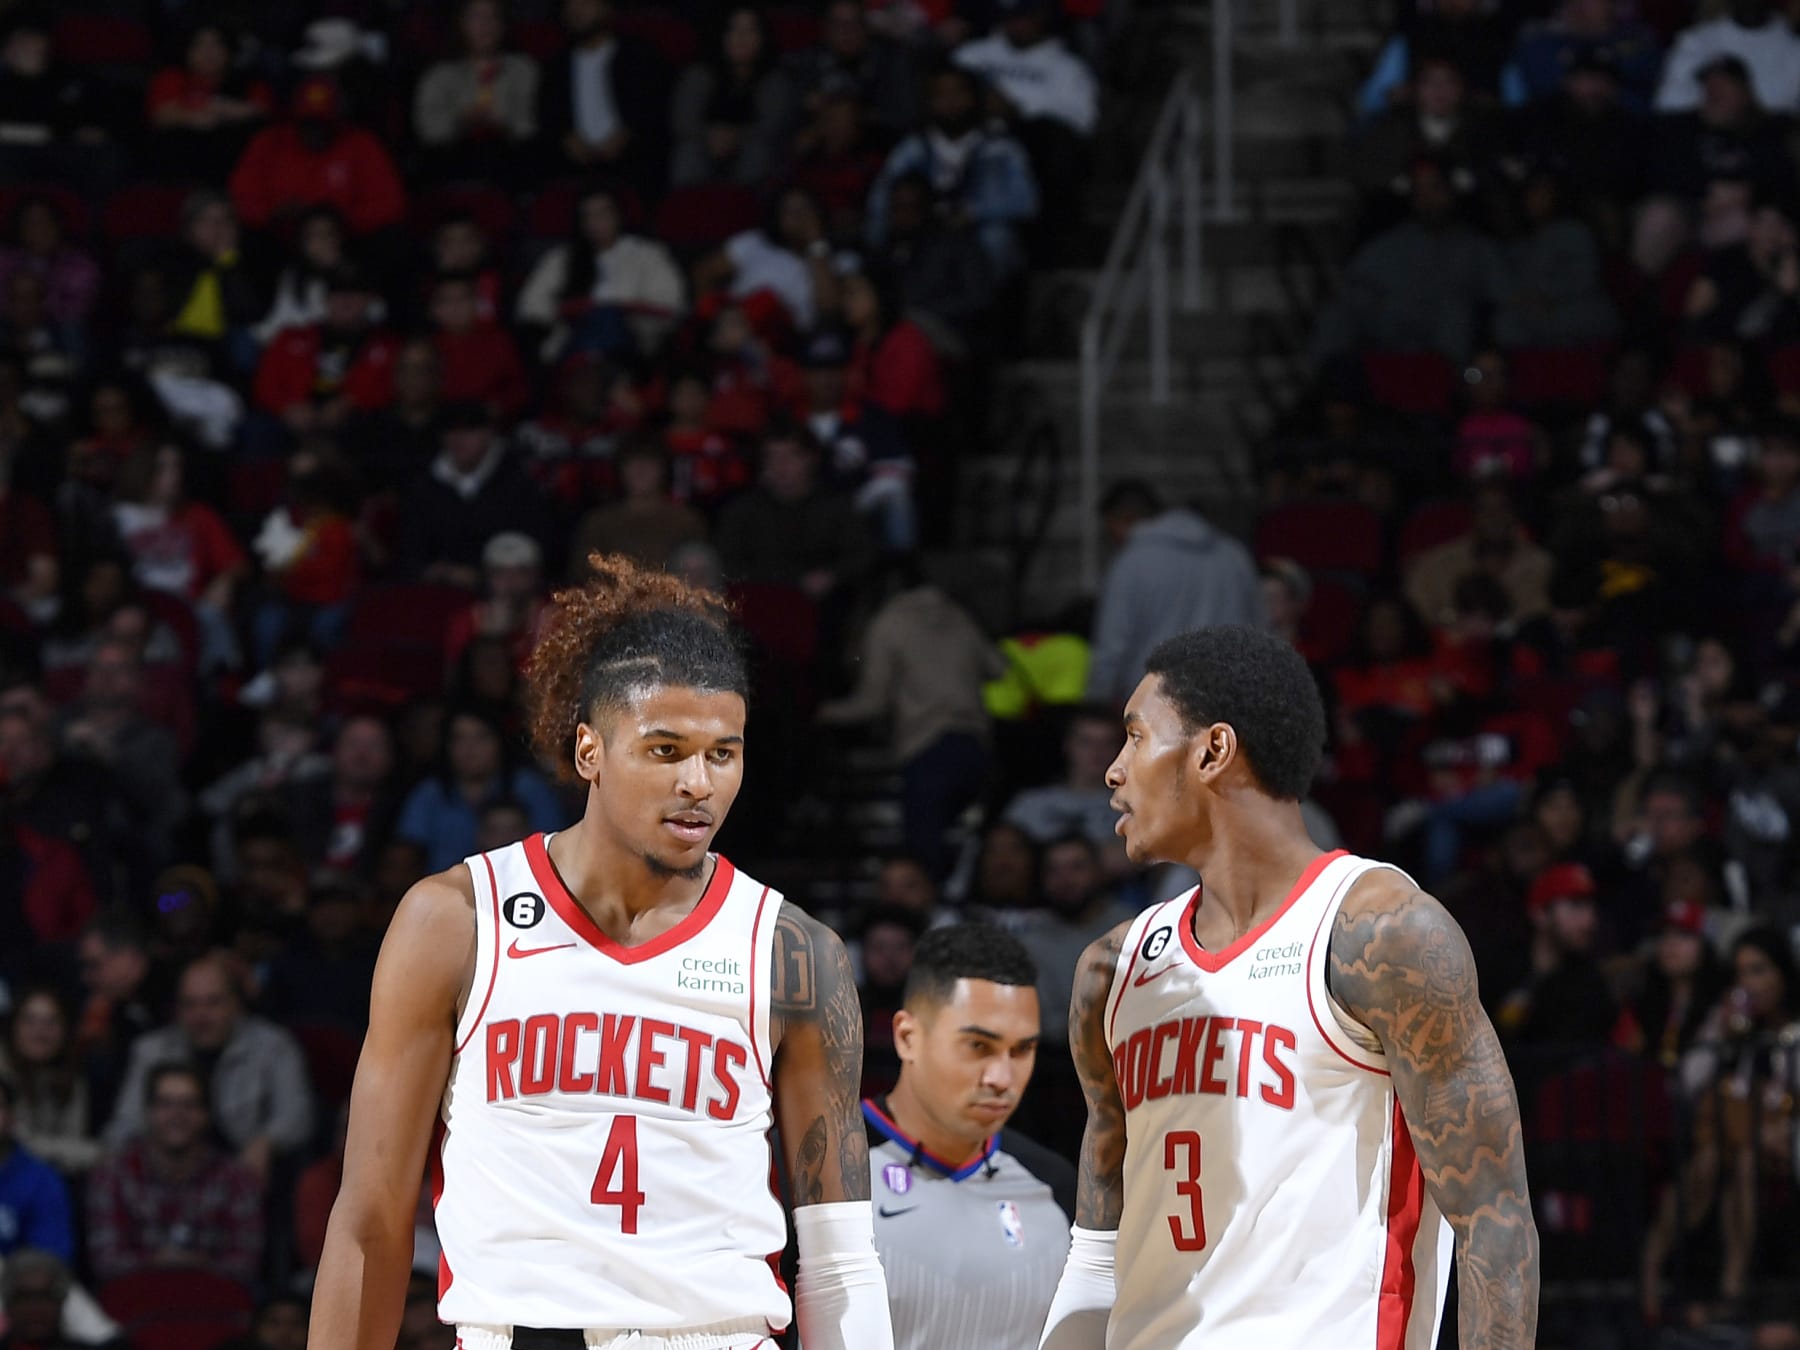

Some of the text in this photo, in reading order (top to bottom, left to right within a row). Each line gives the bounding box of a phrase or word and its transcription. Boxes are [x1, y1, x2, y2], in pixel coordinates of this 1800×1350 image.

[512, 896, 536, 926] 6
[1147, 928, 1169, 957] 6
[1256, 940, 1304, 961] credit
[682, 957, 741, 976] credit
[1247, 962, 1302, 981] karma
[677, 970, 744, 994] karma
[485, 1012, 748, 1121] ROCKETS
[590, 1115, 646, 1234] 4
[1164, 1130, 1207, 1252] 3
